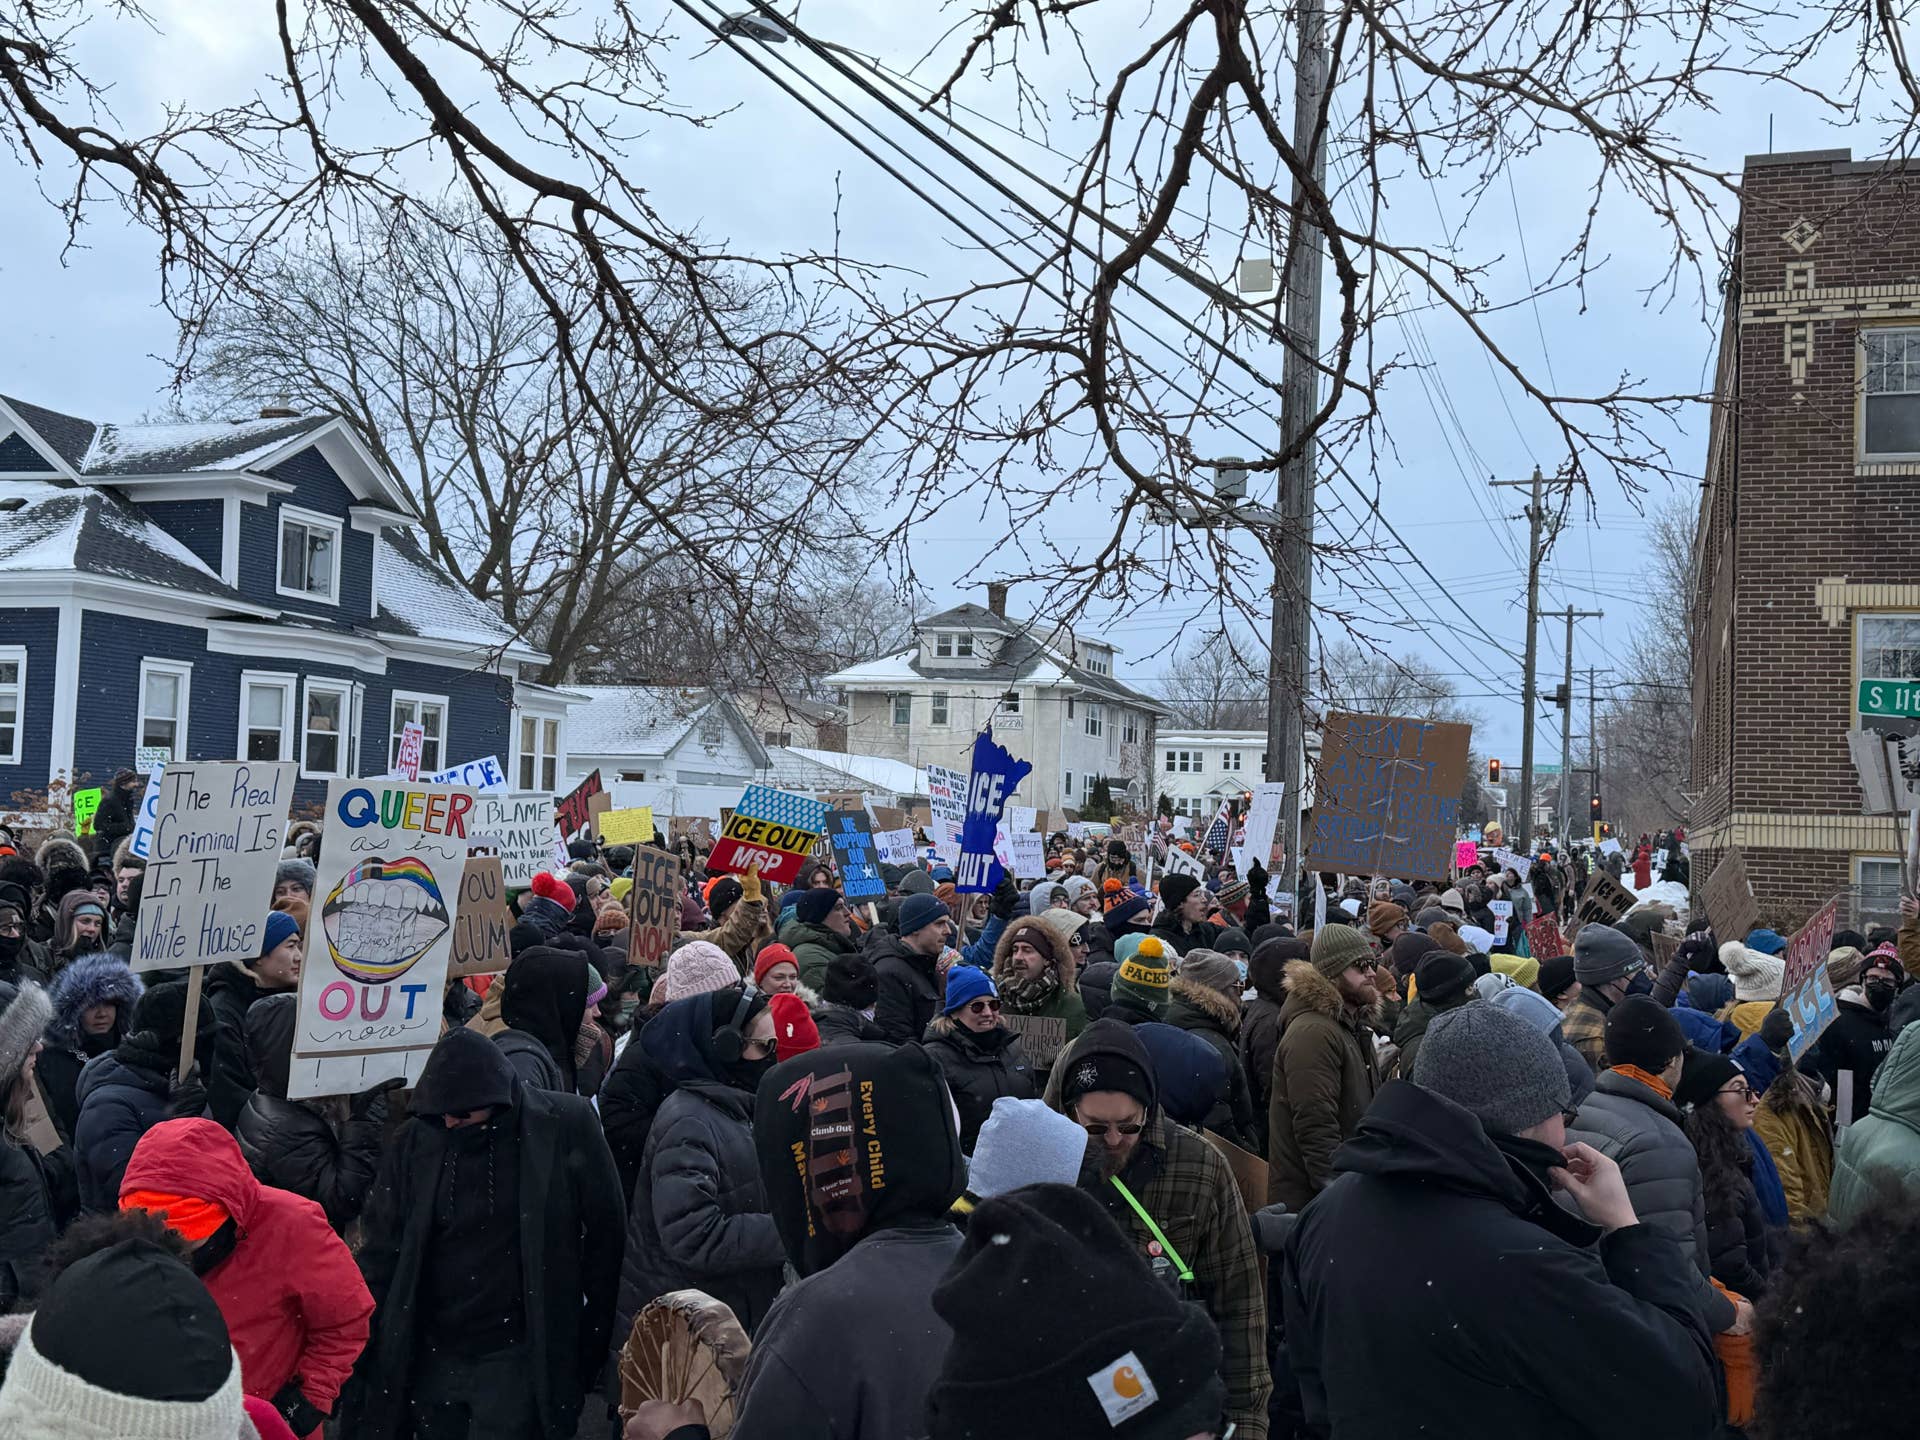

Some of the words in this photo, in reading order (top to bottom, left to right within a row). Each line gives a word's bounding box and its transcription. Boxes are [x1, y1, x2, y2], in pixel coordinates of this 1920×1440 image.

[1869, 686, 1883, 708] S
[1345, 720, 1435, 757] DON'T
[167, 771, 210, 810] The
[230, 766, 280, 808] Real
[1328, 753, 1438, 790] ARREST
[930, 784, 951, 798] POWER
[968, 771, 1006, 818] ICE
[338, 788, 473, 839] QUEER
[486, 801, 551, 825] BLAME
[840, 817, 857, 832] WE
[157, 813, 242, 859] Criminal
[244, 814, 278, 853] Is
[350, 836, 390, 852] as
[404, 834, 456, 860] in
[725, 815, 767, 843] ICE
[765, 826, 817, 853] OUT
[832, 832, 871, 849] SUPPORT
[639, 852, 676, 897] ICE
[729, 846, 783, 874] MSP
[847, 848, 866, 864] OUR
[957, 852, 994, 887] OUT
[144, 862, 181, 899] In
[192, 858, 231, 894] The
[843, 879, 886, 897] NEIGHBOR
[1592, 878, 1616, 900] ICE
[1611, 893, 1633, 914] OUT
[636, 889, 674, 927] OUT
[140, 904, 186, 960] White
[198, 903, 255, 957] House
[633, 924, 672, 961] NOW
[1782, 902, 1837, 995] ABOLISH
[318, 980, 427, 1021] OUT
[1782, 961, 1831, 1046] ICE
[309, 1017, 428, 1043] now
[860, 1080, 877, 1136] Every
[811, 1126, 835, 1137] Climb
[836, 1124, 853, 1134] Out
[867, 1139, 886, 1190] Child
